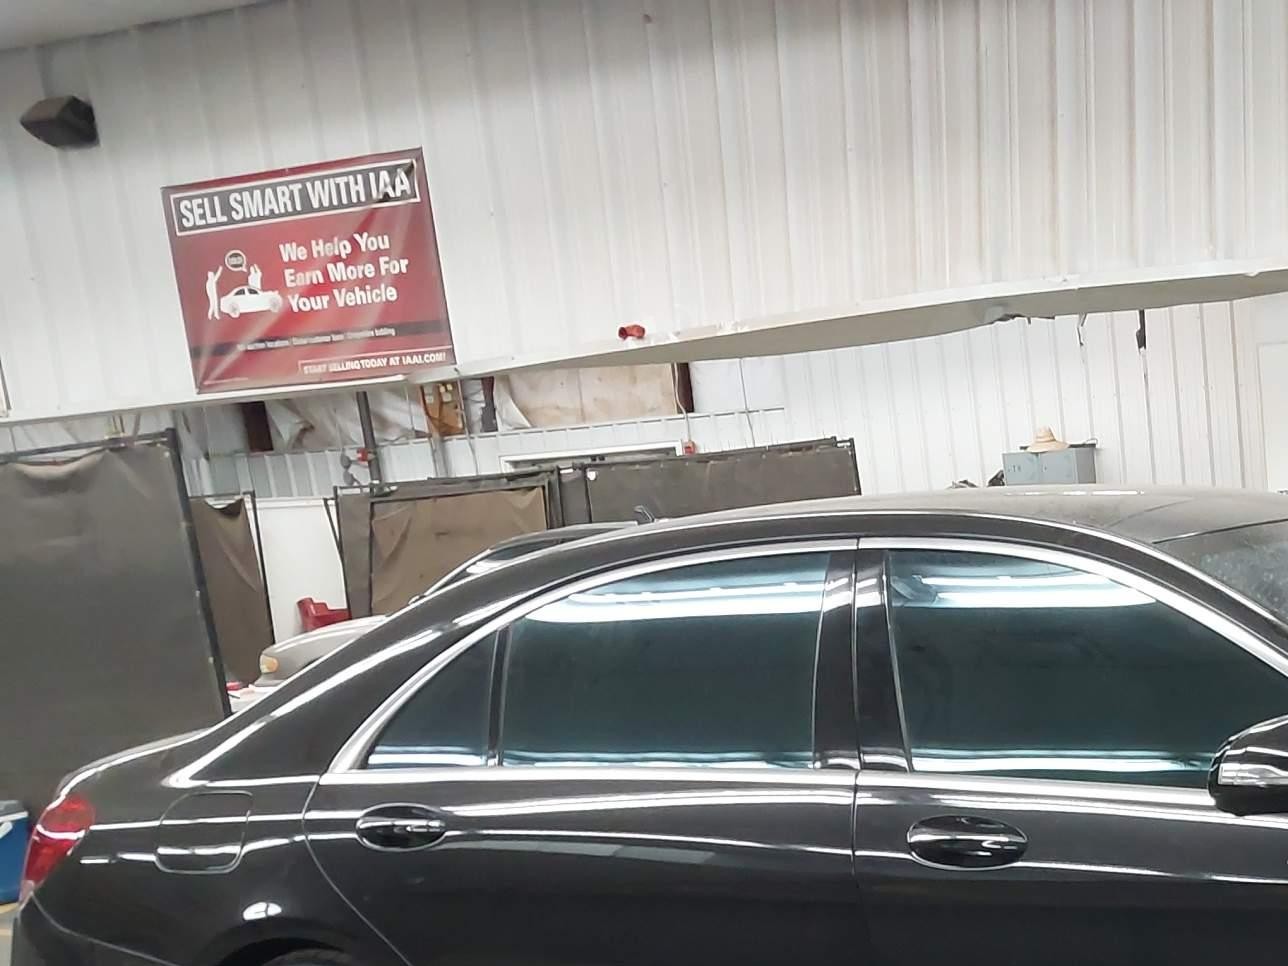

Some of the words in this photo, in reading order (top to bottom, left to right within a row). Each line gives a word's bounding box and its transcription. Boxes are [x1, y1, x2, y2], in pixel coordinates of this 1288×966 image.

[180, 196, 227, 228] SELL
[229, 183, 303, 220] SMART
[306, 174, 366, 208] WITH
[369, 168, 412, 200] IAA
[279, 242, 308, 262] We
[311, 236, 352, 259] Help
[353, 232, 390, 252] You
[284, 268, 325, 288] Earn
[327, 261, 375, 282] More
[379, 256, 409, 276] For
[288, 293, 330, 313] Your
[333, 283, 398, 308] Vehicle
[361, 357, 388, 370] TODAY
[389, 356, 400, 367] AT
